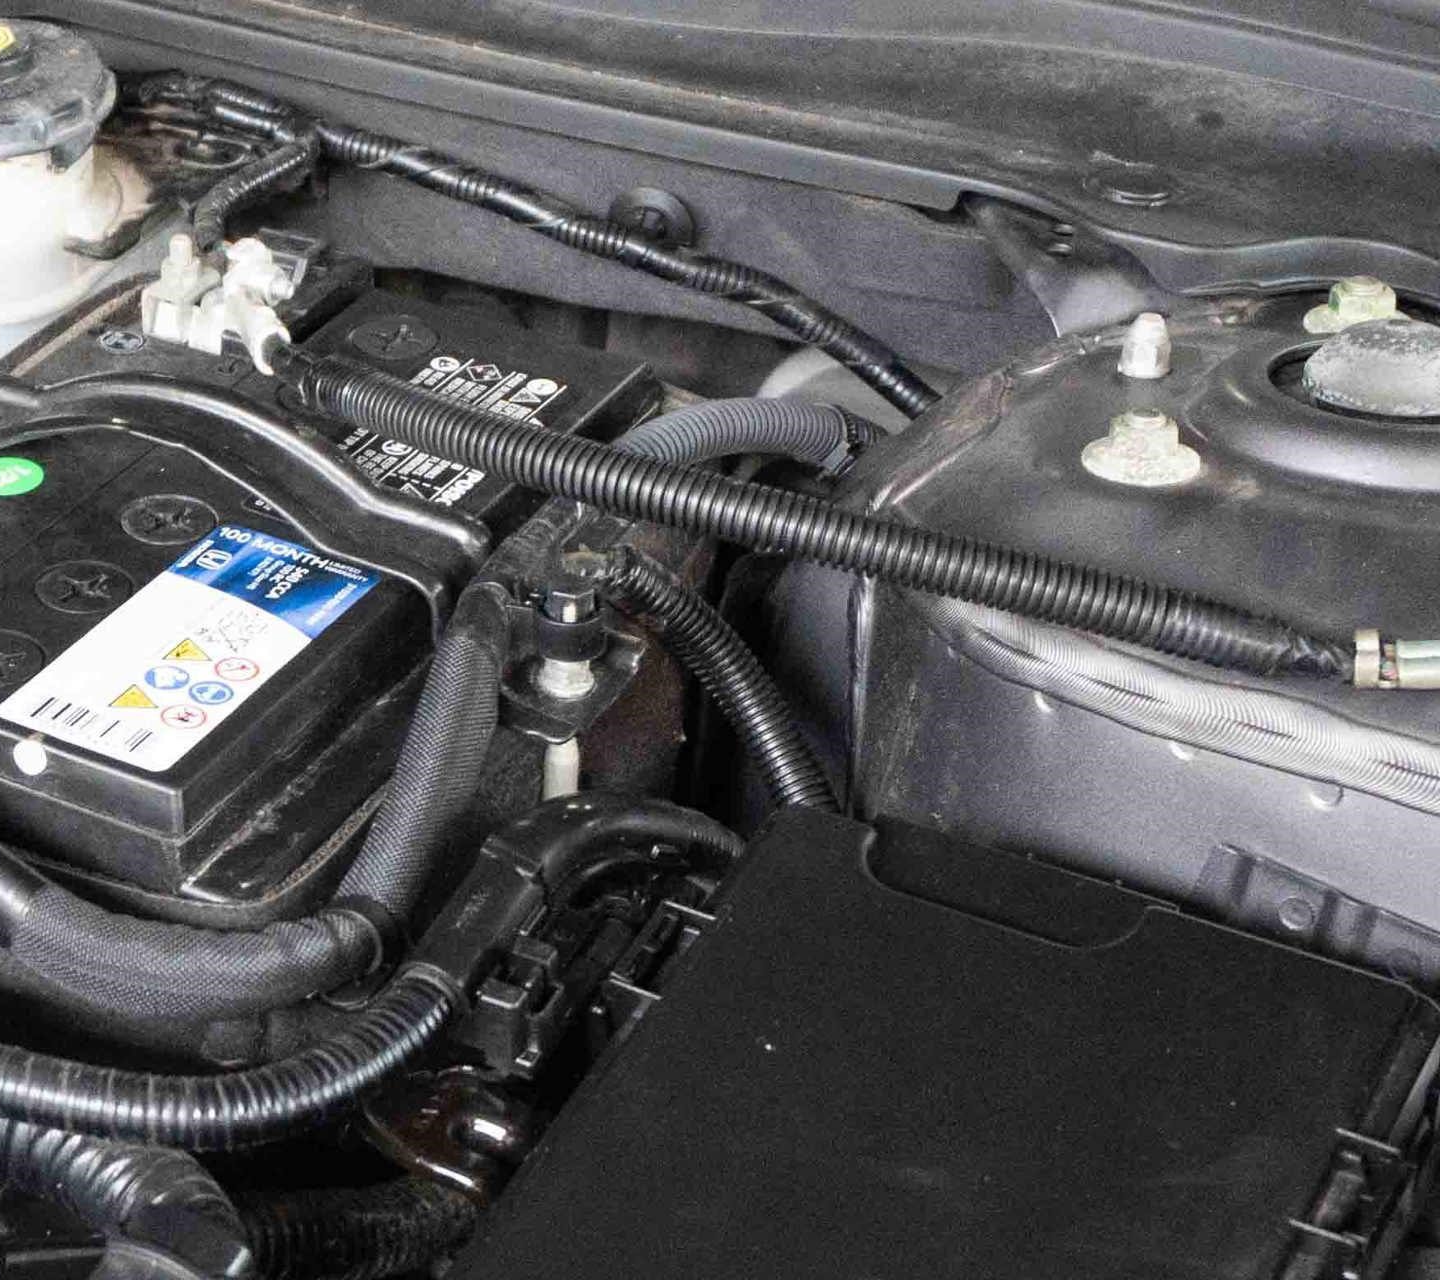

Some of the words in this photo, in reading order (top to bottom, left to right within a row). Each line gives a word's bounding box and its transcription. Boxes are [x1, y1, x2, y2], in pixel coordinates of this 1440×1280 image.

[219, 526, 252, 544] 100
[249, 538, 329, 569] MONTH
[264, 581, 292, 599] CCA
